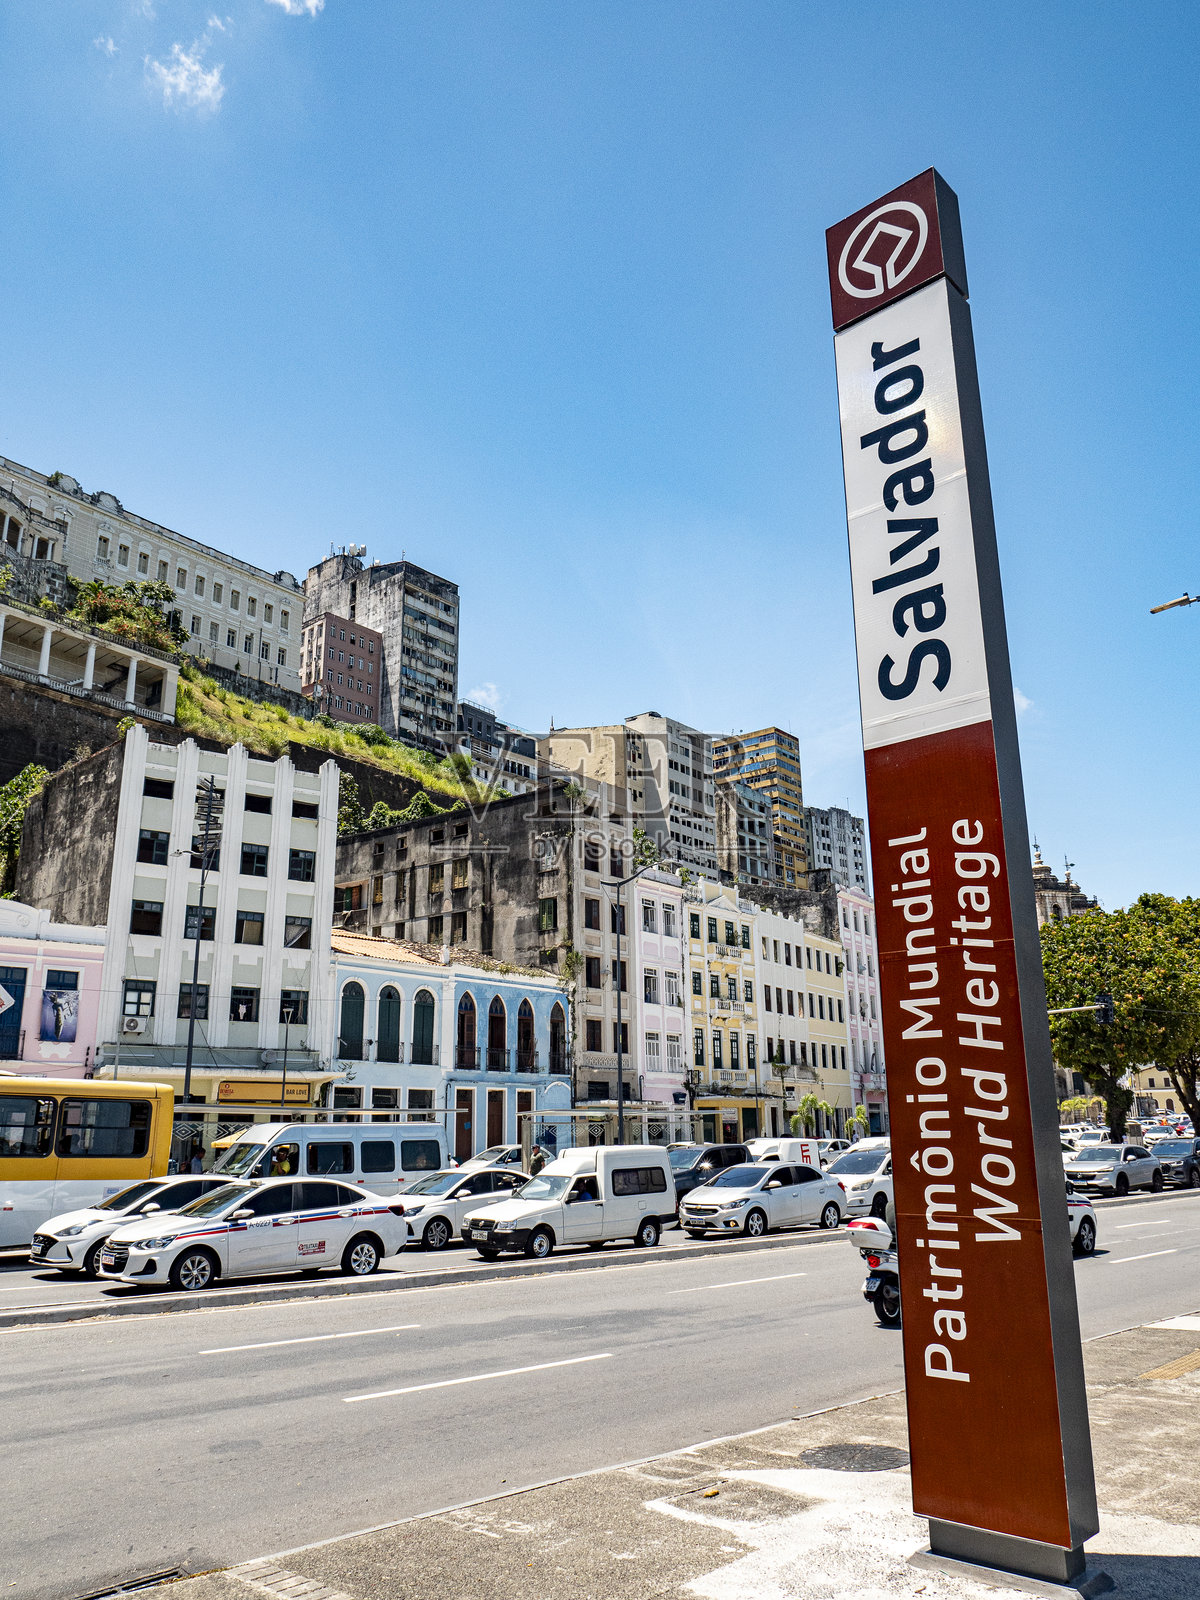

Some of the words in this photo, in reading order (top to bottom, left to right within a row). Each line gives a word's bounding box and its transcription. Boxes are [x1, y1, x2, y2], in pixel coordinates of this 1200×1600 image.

[860, 337, 952, 701] Salvador
[887, 826, 943, 1041] Mundial
[951, 818, 1005, 1051] Heritage
[905, 1056, 971, 1383] Patrimônio
[963, 1069, 1023, 1243] World
